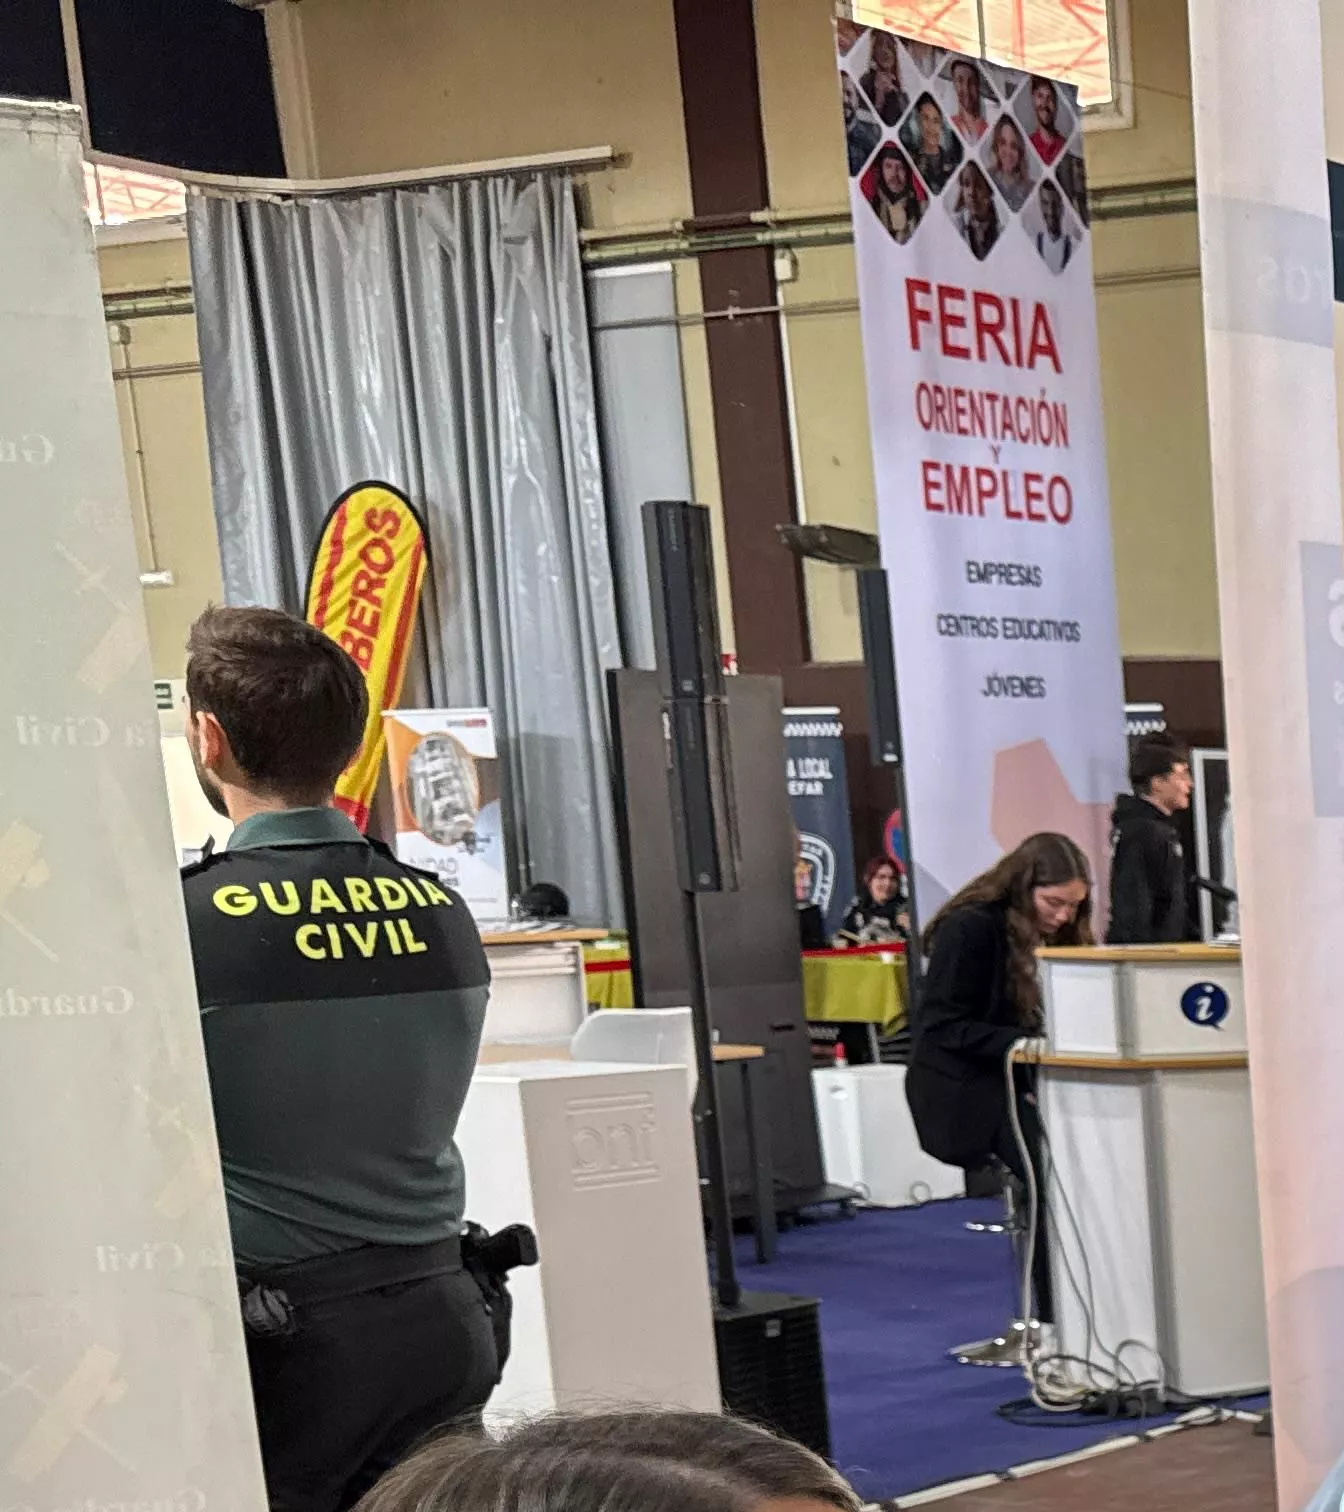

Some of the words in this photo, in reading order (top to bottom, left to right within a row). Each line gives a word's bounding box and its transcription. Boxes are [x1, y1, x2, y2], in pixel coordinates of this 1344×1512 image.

[904, 278, 1063, 375] FERIA
[914, 381, 1070, 450] ORIENTACIÓN
[991, 444, 1003, 465] Y
[922, 460, 1074, 526] EMPLEO
[337, 506, 402, 673] BEROS
[966, 559, 1043, 589] EMPRESAS
[937, 612, 1000, 642] CENTROS
[1002, 617, 1081, 644] EDUCATIVOS
[981, 670, 1047, 700] JÓVENES
[788, 779, 825, 797] EFAR
[212, 875, 455, 918] GUARDIA
[294, 917, 429, 961] CIVIL
